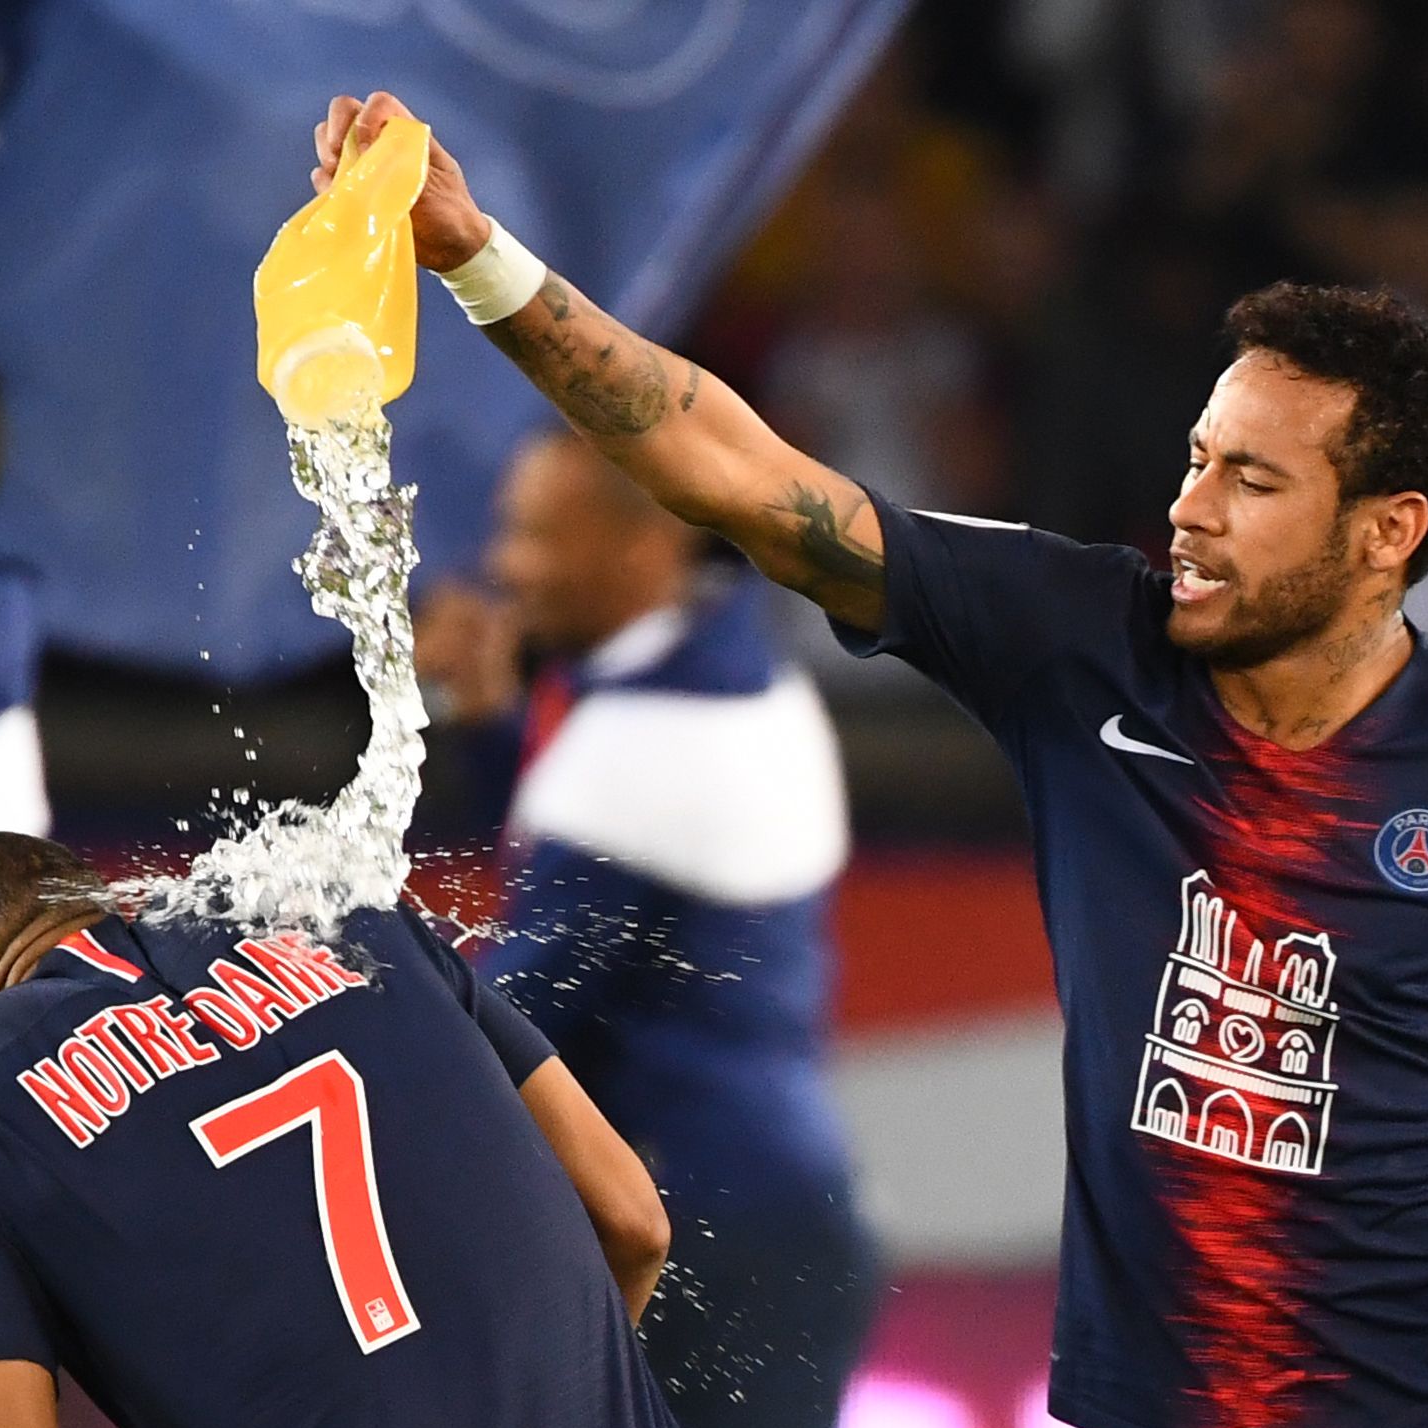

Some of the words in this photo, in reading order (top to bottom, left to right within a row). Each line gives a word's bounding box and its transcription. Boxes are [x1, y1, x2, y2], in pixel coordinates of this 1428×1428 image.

[16, 993, 221, 1149] NOTRE
[181, 931, 369, 1052] DAME
[188, 1049, 421, 1355] 7
